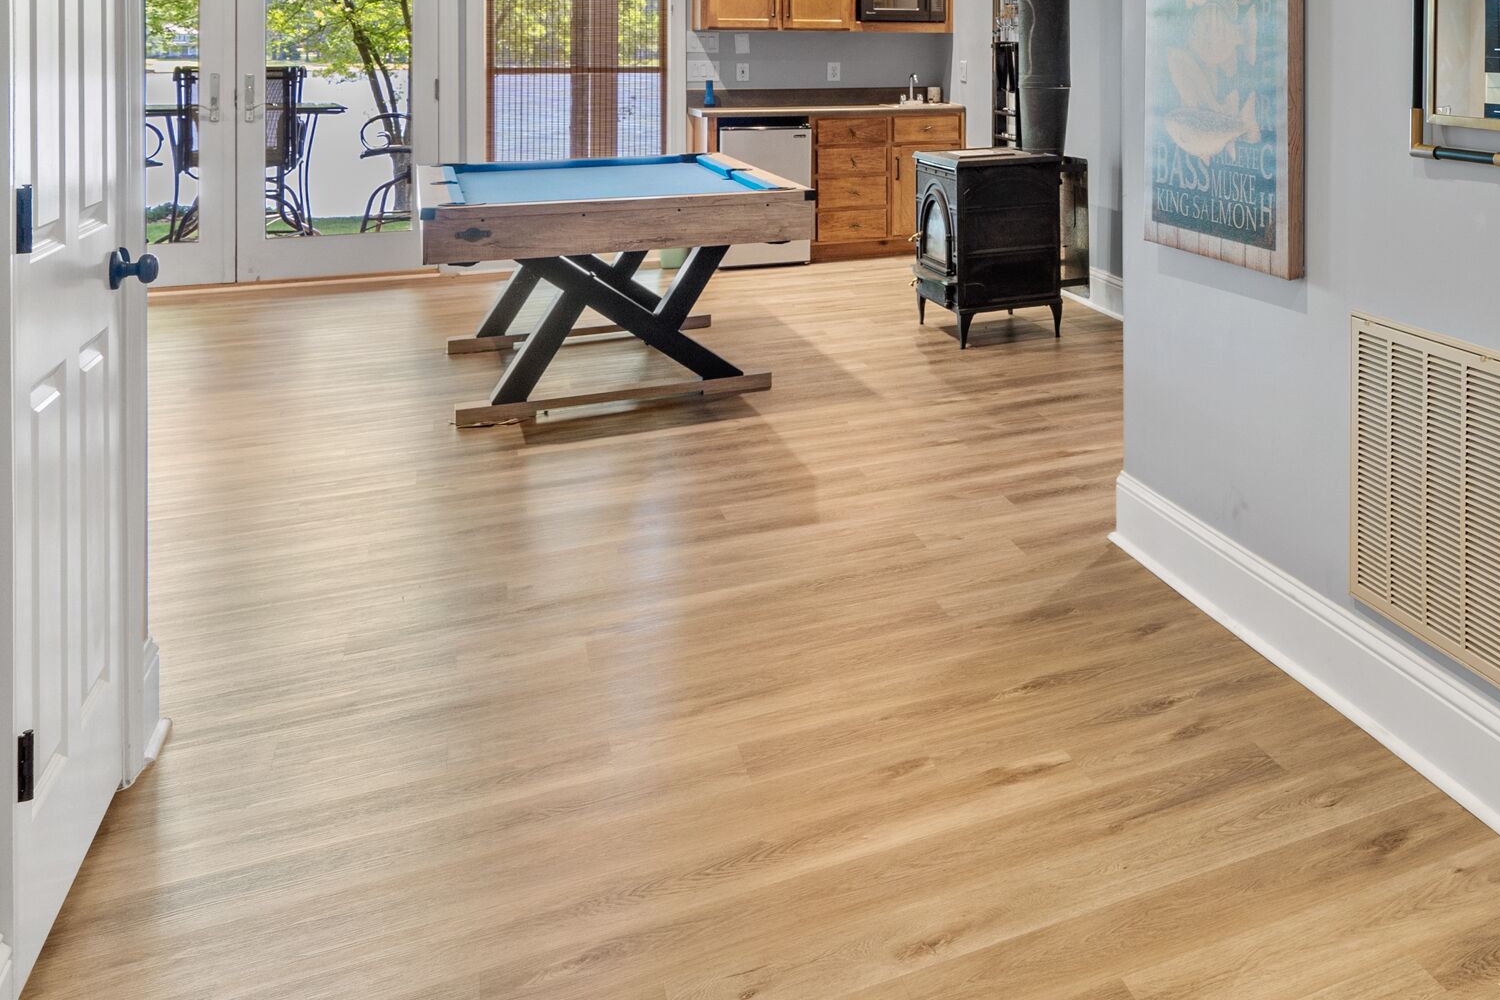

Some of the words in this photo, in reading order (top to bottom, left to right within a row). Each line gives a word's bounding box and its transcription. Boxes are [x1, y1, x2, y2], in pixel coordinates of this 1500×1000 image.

[1157, 141, 1209, 192] BASS
[1212, 169, 1256, 205] MUSKE
[1158, 188, 1189, 217] KING
[1193, 194, 1257, 232] SALMON
